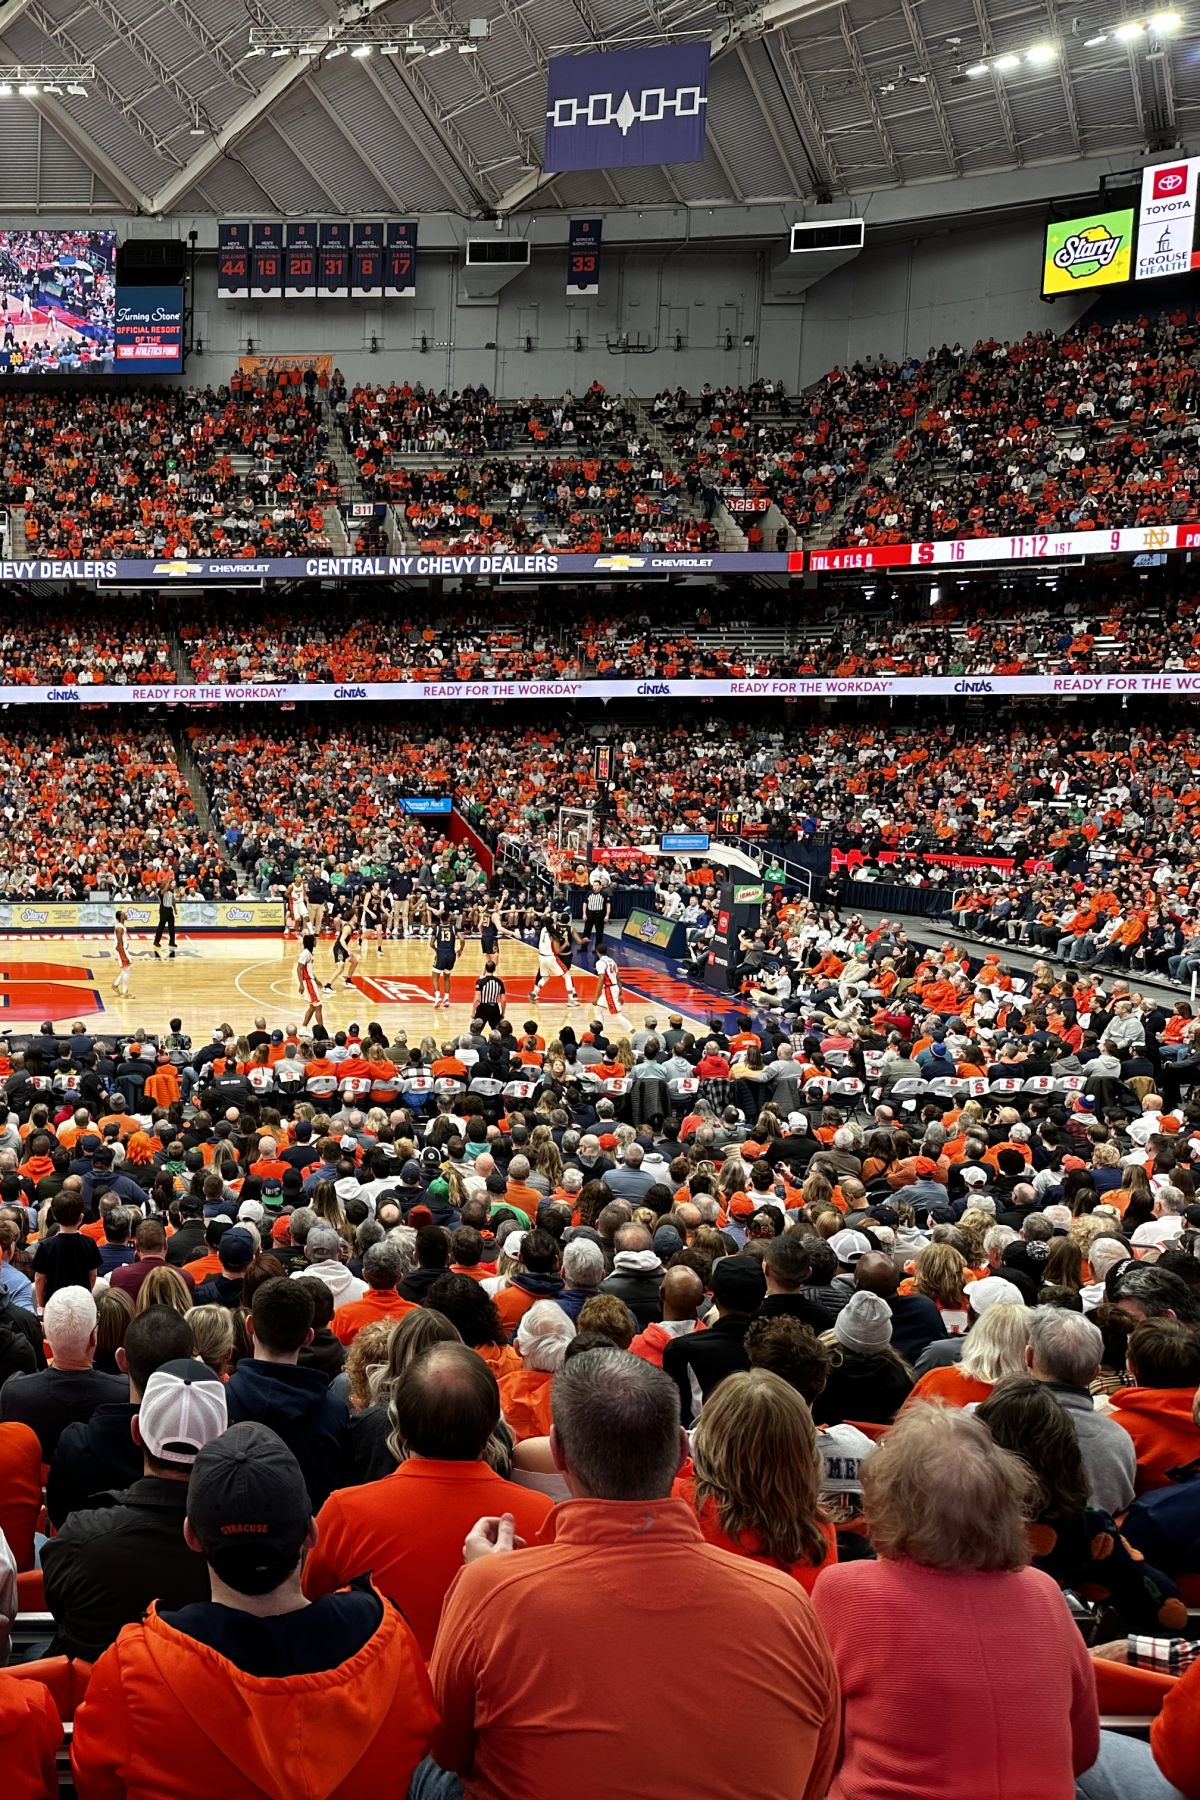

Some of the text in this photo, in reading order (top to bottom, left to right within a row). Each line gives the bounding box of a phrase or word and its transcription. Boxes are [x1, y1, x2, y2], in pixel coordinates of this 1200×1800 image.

[1146, 200, 1191, 215] TOYOTA
[1054, 234, 1124, 269] Starry
[1140, 251, 1188, 267] CROUSE
[221, 261, 245, 276] 44
[258, 260, 276, 276] 19
[290, 260, 312, 275] 20
[325, 260, 343, 275] 31
[362, 260, 373, 275] 8
[392, 260, 410, 275] 17
[572, 256, 595, 272] 33
[1140, 261, 1187, 276] HEALTH
[116, 307, 179, 322] Turning Stone
[116, 326, 150, 334] OFFICIAL
[354, 505, 372, 515] 311
[1010, 535, 1072, 558] 11:12 1ST
[1110, 530, 1120, 551] 9
[918, 543, 935, 564] S
[950, 542, 965, 561] 16
[40, 561, 117, 578] DEALERS
[209, 564, 270, 573] CHEVROLET
[306, 555, 559, 575] CENTRAL NY CHEVY DEALERS
[651, 558, 713, 567] CHEVROLET
[833, 556, 841, 569] 4
[844, 555, 862, 568] FLS
[423, 685, 463, 697] READY
[465, 685, 490, 696] FOR
[491, 684, 516, 696] THE
[730, 682, 770, 693] READY
[771, 682, 797, 693] FOR
[799, 681, 823, 693] THE
[1053, 678, 1104, 691] READY
[1106, 678, 1138, 691] FOR
[1140, 677, 1173, 690] THE
[132, 688, 171, 700] READY
[173, 688, 197, 699] FOR
[198, 688, 222, 699] THE
[20, 907, 50, 923] Starry
[126, 907, 152, 922] Starry
[225, 907, 255, 922] Starry
[440, 930, 451, 941] 13
[220, 1524, 269, 1535] SYRACUSE
